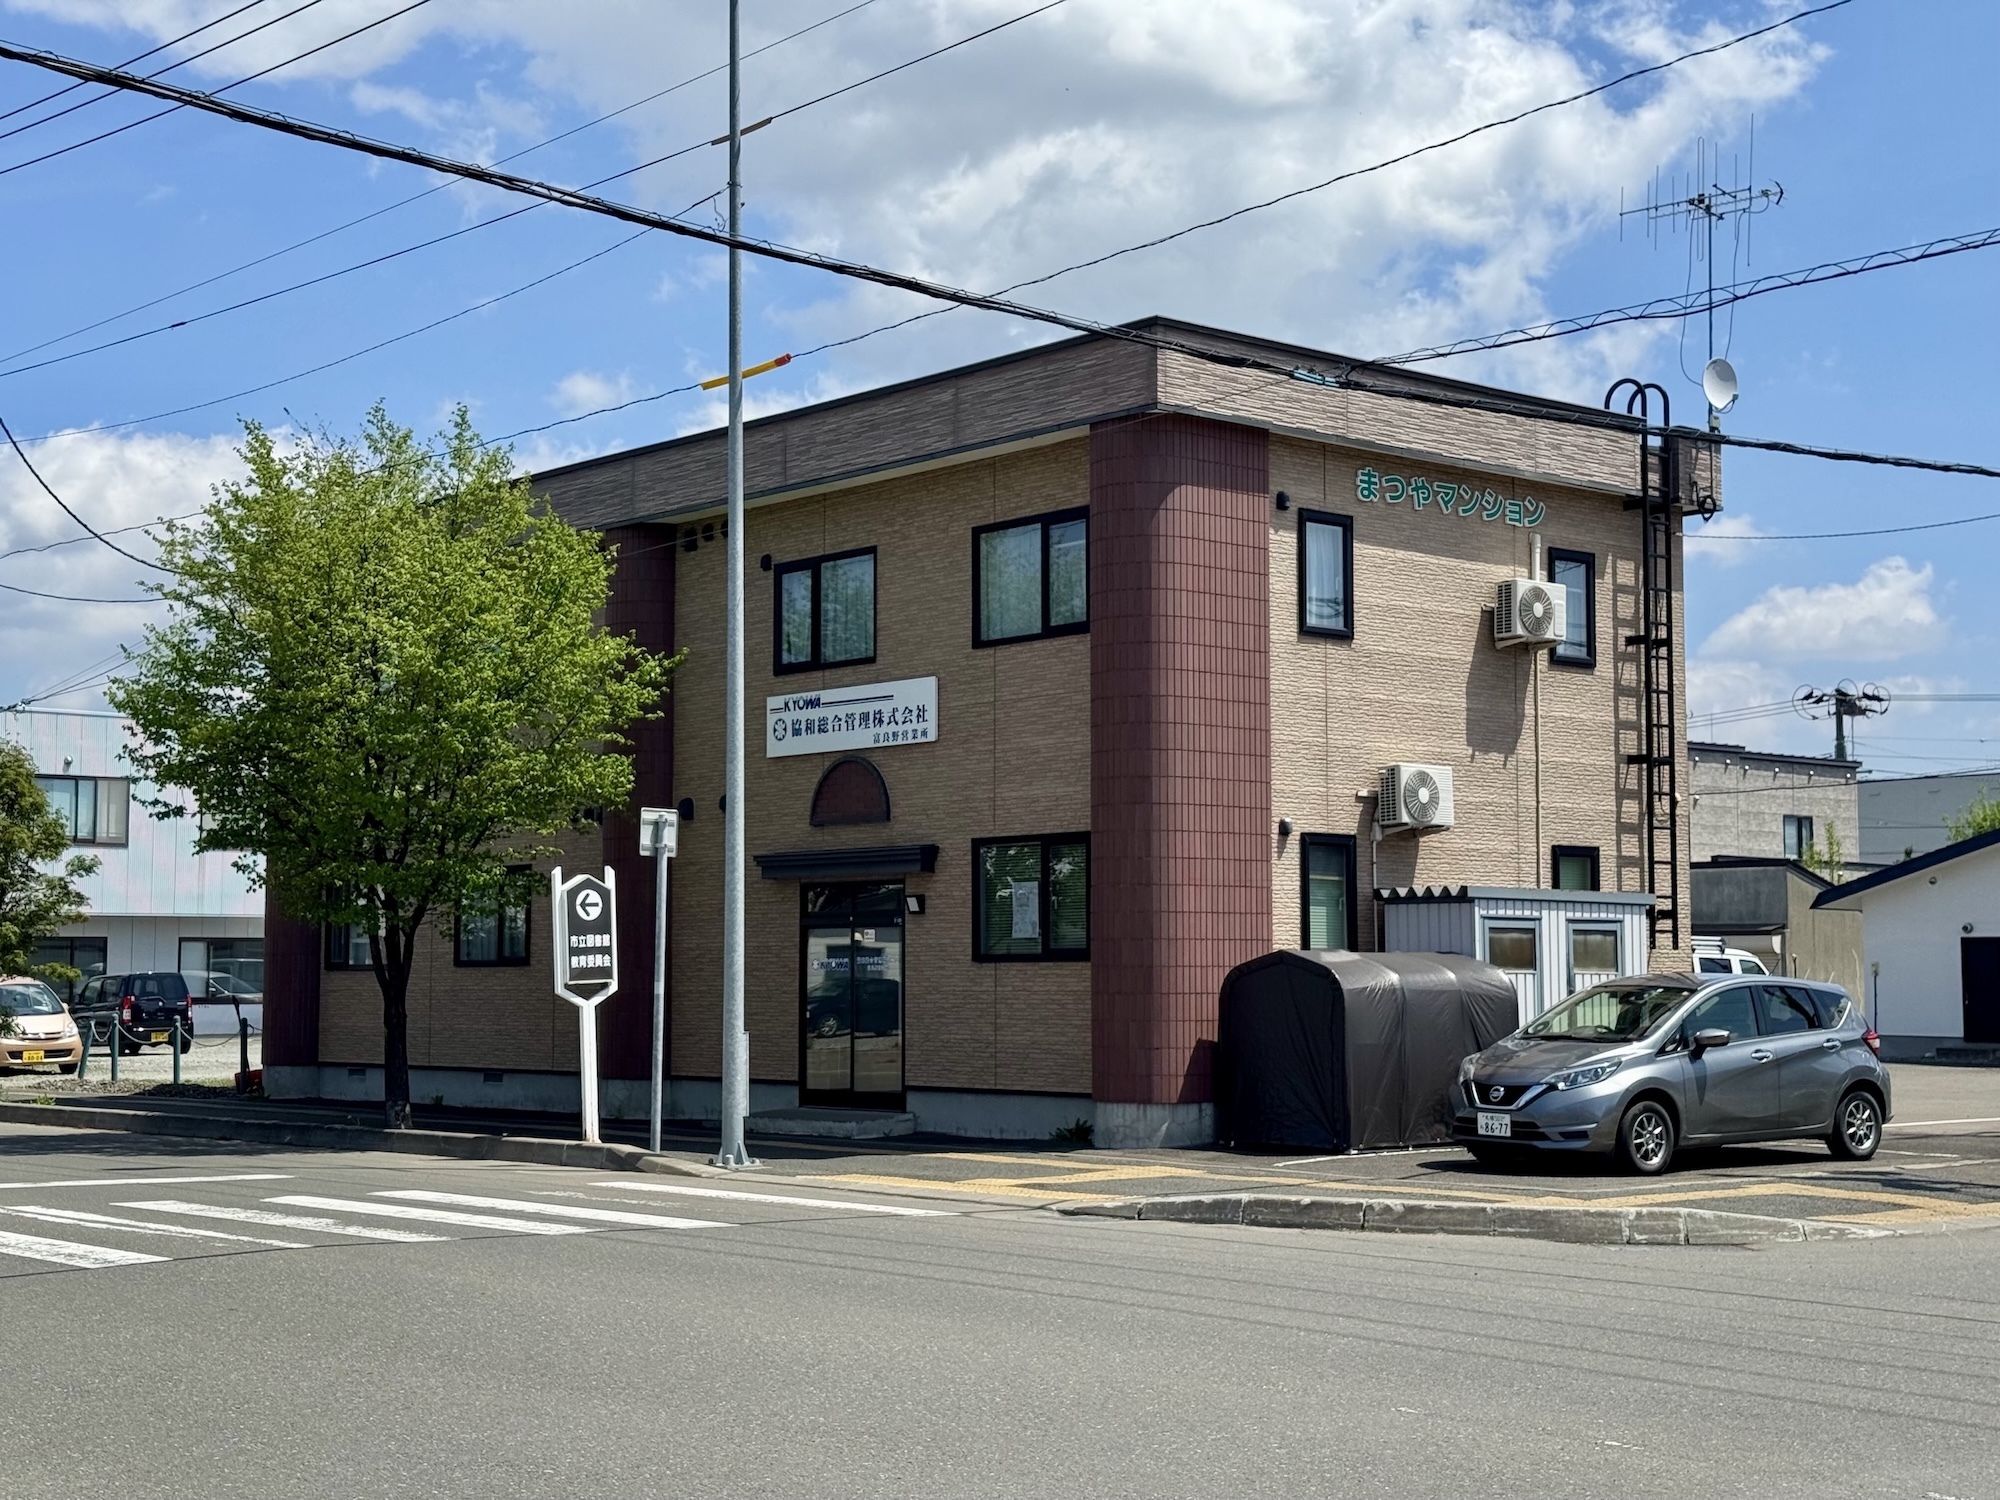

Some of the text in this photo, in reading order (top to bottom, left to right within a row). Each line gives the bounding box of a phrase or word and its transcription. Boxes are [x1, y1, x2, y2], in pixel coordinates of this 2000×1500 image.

[1356, 467, 1546, 527] まつやマンション
[784, 694, 821, 712] KYOWA
[791, 704, 929, 738] 協和総合管理株式会社
[872, 727, 929, 744] 富良野営業所
[1484, 1121, 1509, 1135] 86-77
